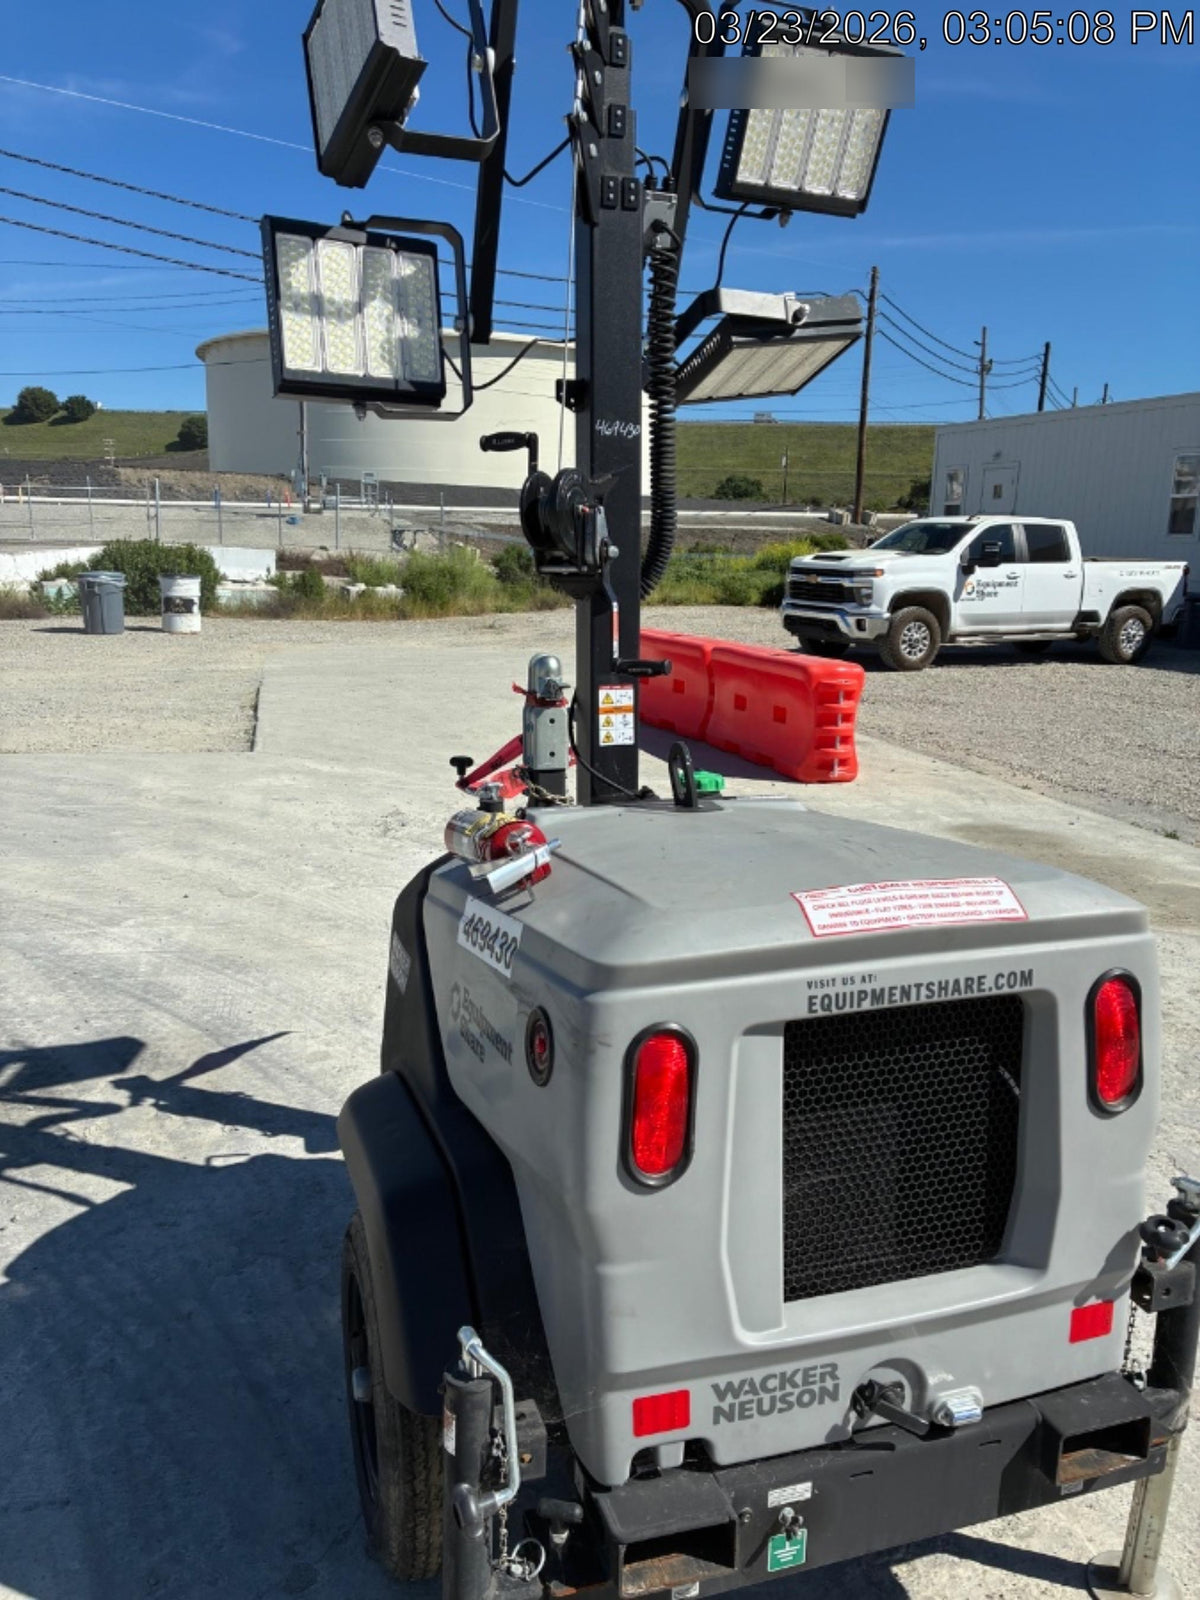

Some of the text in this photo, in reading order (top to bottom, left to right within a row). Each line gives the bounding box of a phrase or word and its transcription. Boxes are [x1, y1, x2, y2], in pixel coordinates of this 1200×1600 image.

[463, 912, 519, 970] 469430
[806, 973, 878, 990] VISIT US AT:
[807, 969, 1034, 1013] EQUIPMENTSHARE.COM
[463, 986, 513, 1067] Equipment
[711, 1363, 840, 1402] WACKER
[712, 1382, 840, 1425] NEUSON
